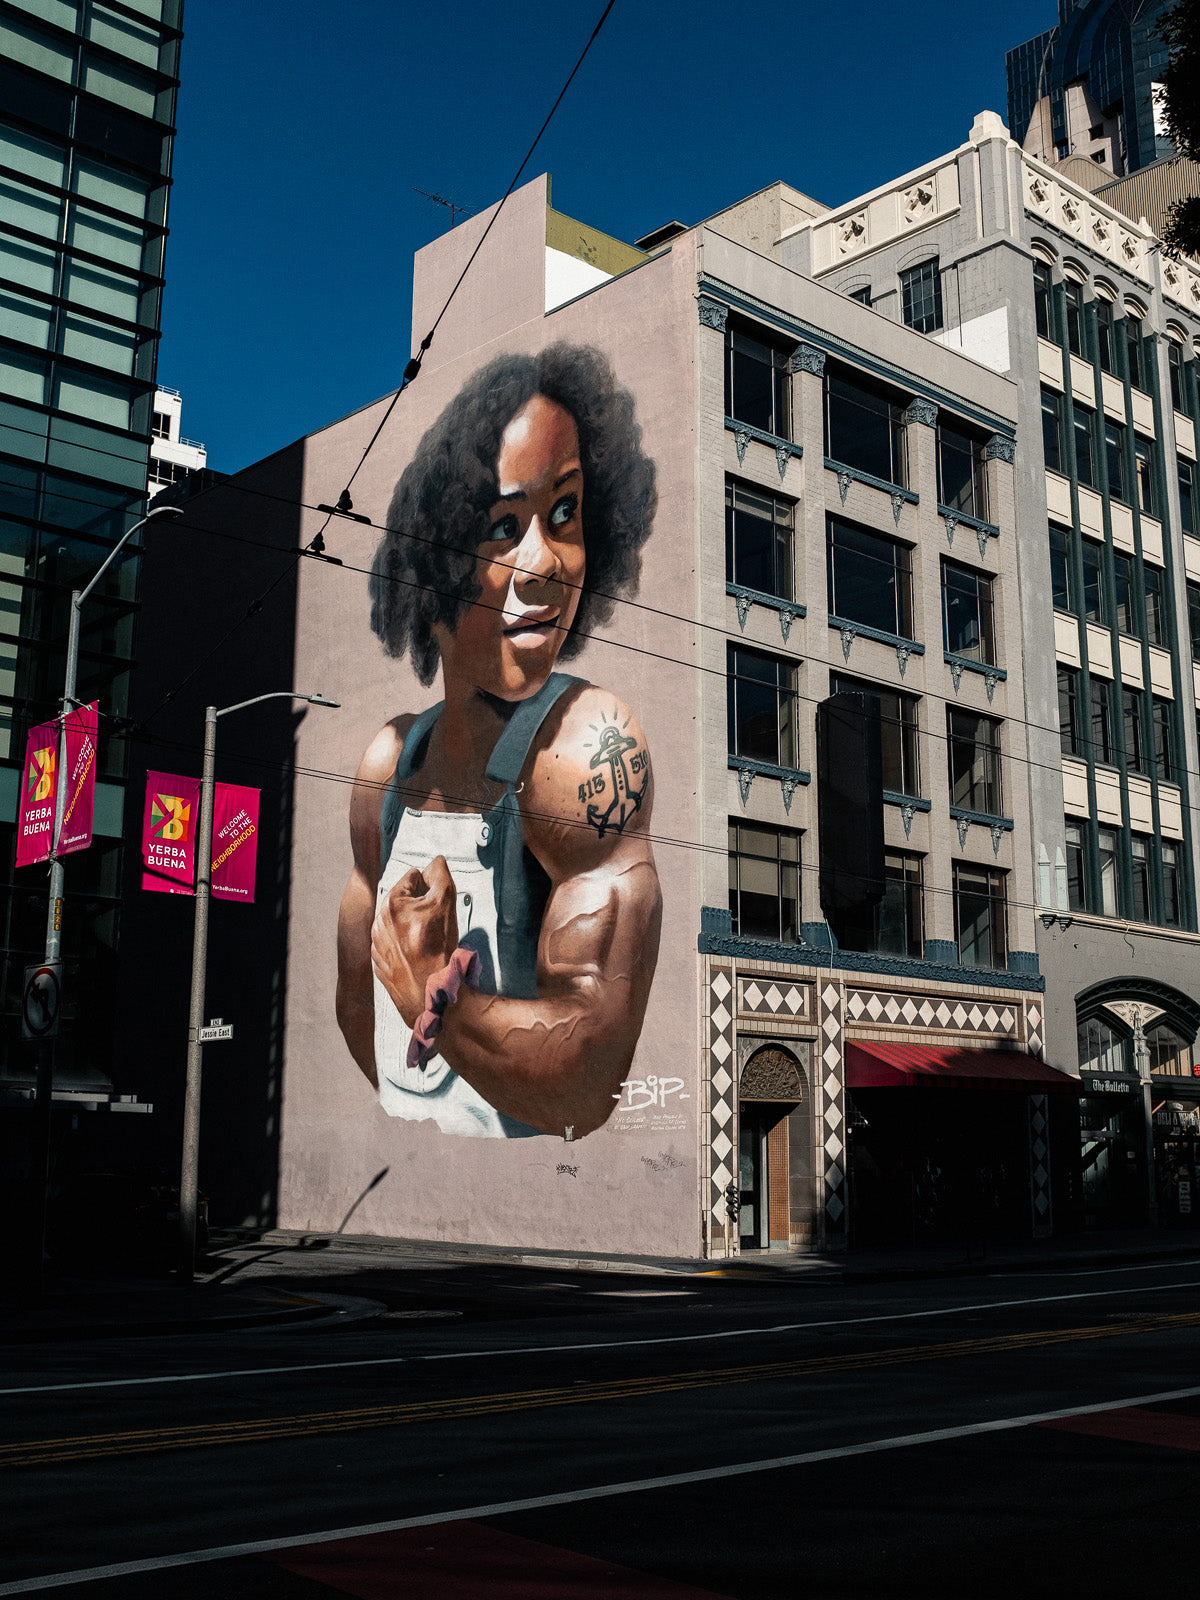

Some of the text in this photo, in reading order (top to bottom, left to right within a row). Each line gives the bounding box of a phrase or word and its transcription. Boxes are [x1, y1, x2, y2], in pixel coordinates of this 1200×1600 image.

[71, 734, 91, 781] WELCOME
[83, 741, 93, 760] THE
[63, 748, 95, 825] NEIGHBORHOOD
[578, 773, 606, 803] 415
[25, 806, 52, 822] YERBA
[23, 820, 51, 836] BUENA
[218, 809, 248, 839] WELCOME
[229, 816, 253, 840] TO THE
[148, 843, 187, 858] YERBA
[210, 824, 256, 873] NEIGHBORHOOD
[147, 855, 187, 870] BUENA
[211, 885, 249, 895] YerbaBuena.org
[201, 1028, 230, 1038] Jessie East
[1092, 1079, 1130, 1093] The Bulletin
